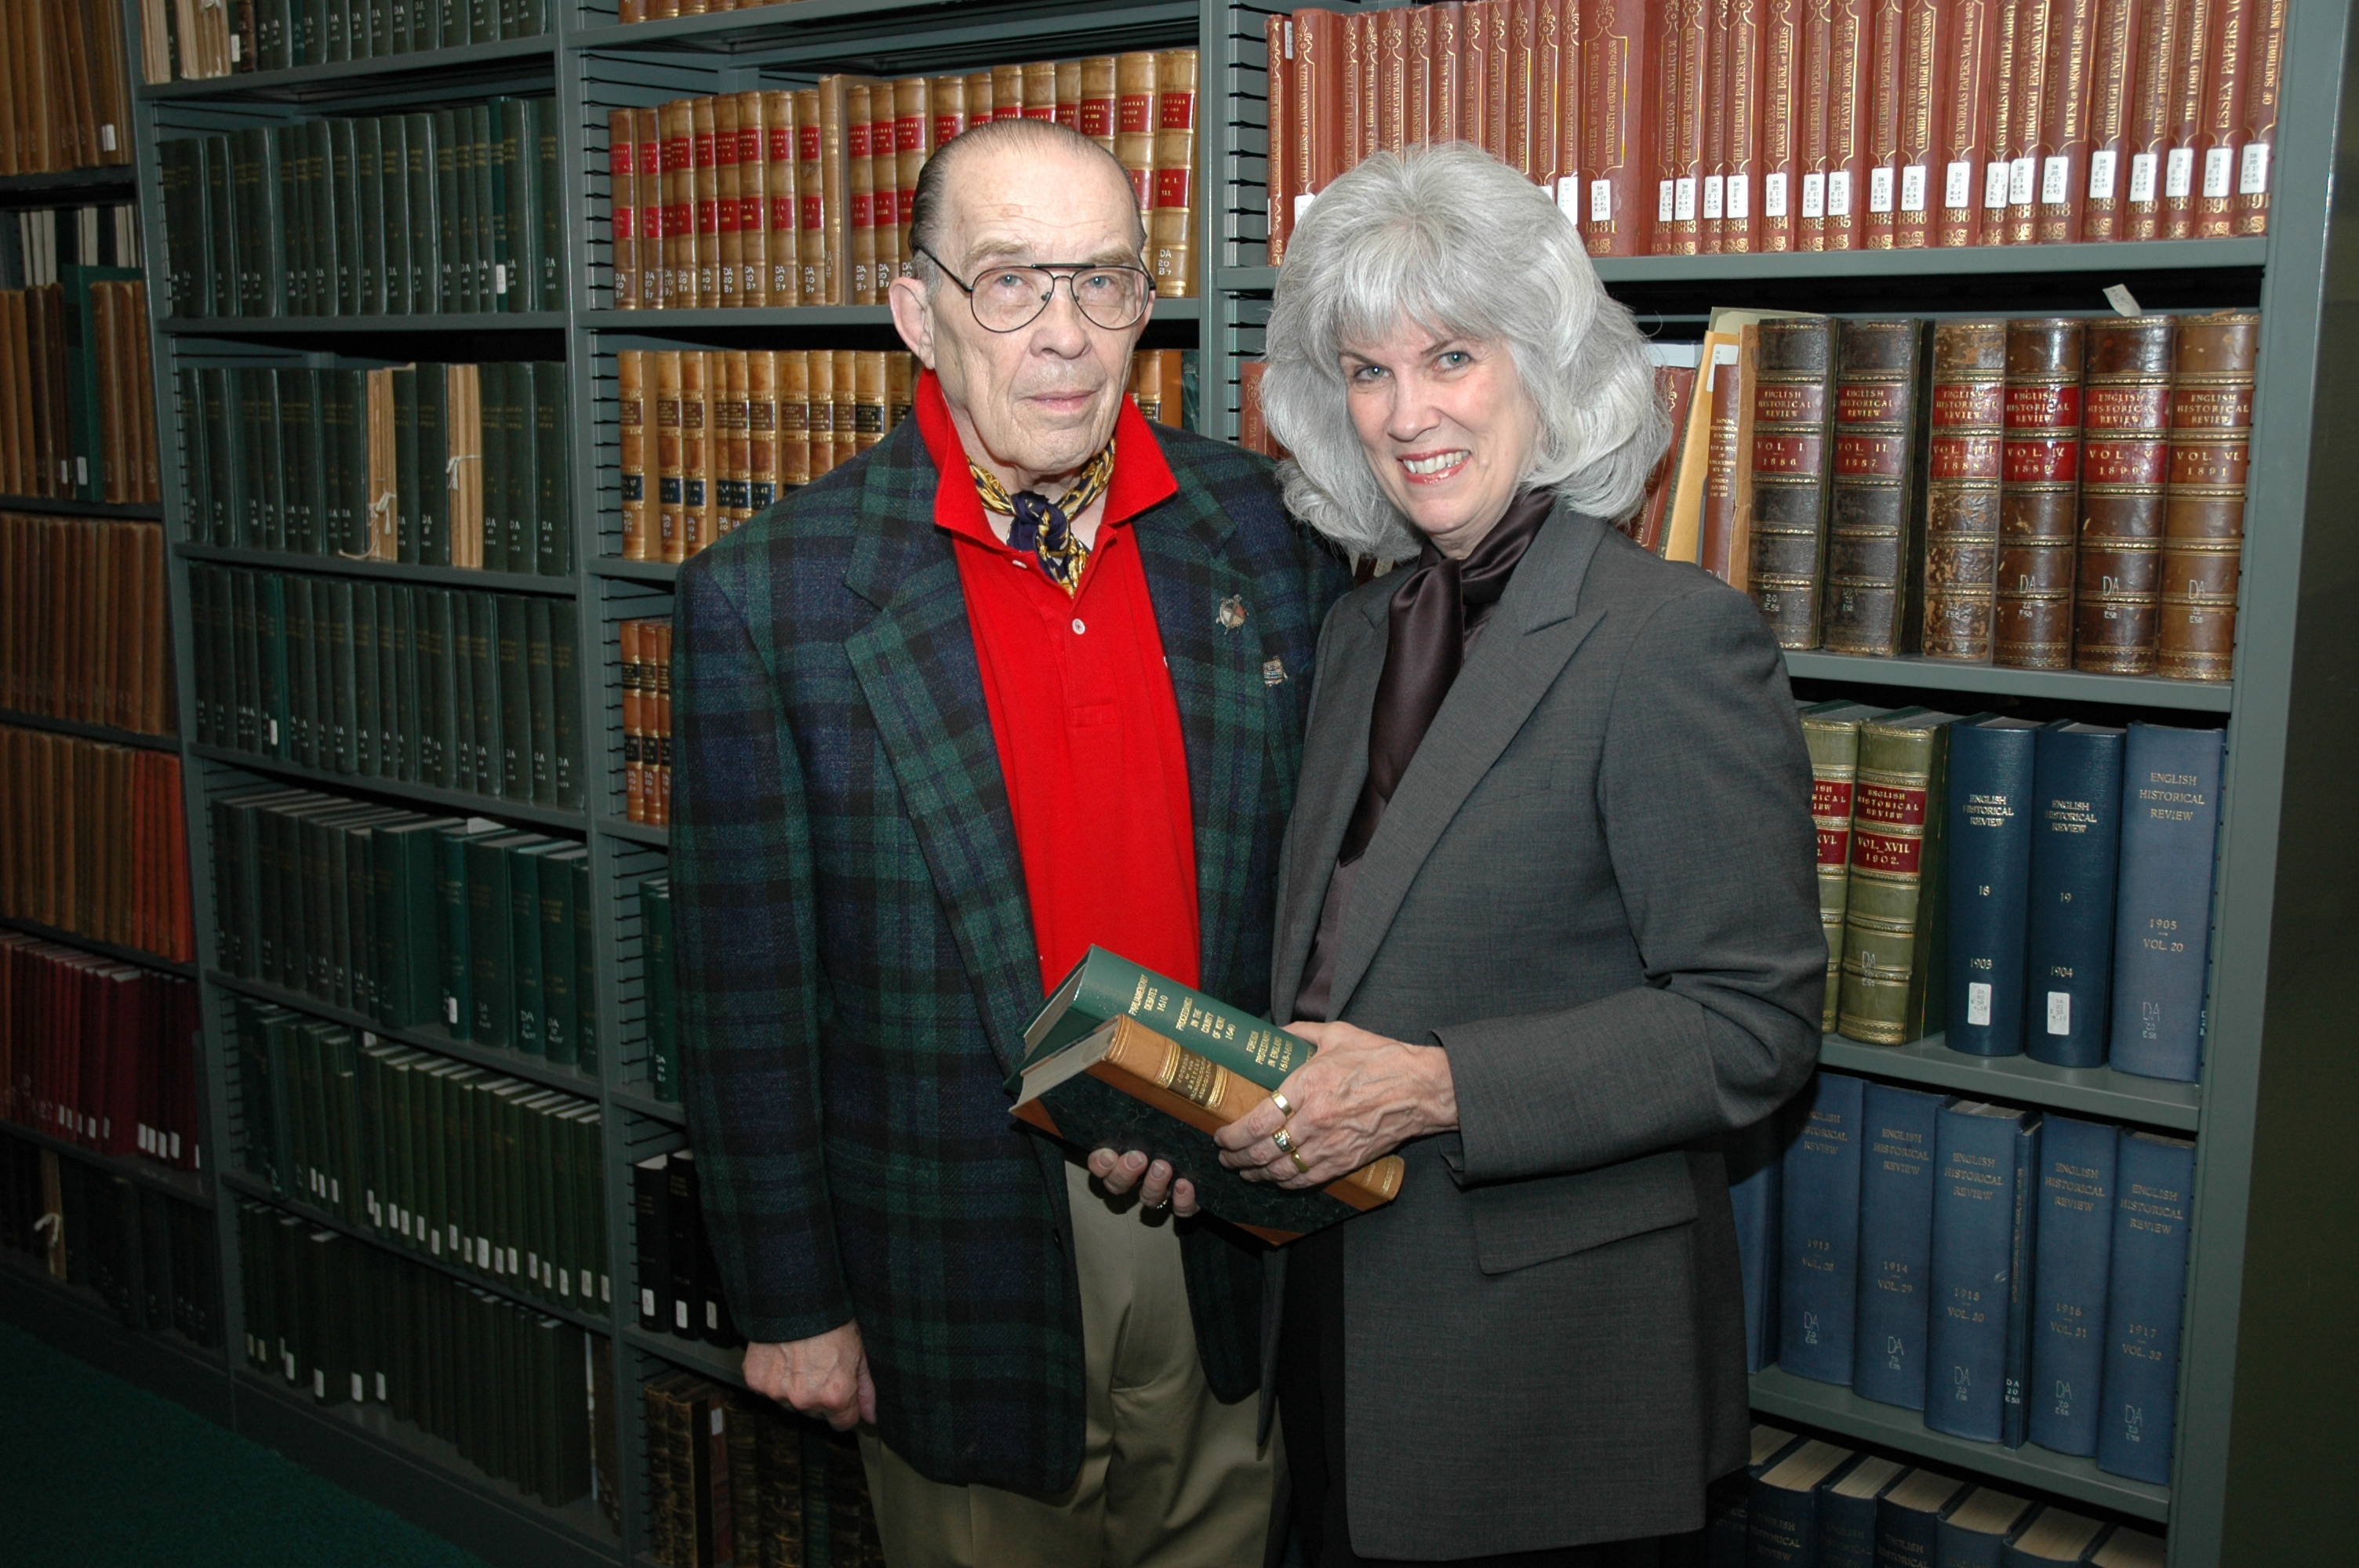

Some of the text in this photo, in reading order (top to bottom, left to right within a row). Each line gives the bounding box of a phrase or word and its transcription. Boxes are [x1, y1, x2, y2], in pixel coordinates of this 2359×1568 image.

[1910, 13, 1920, 35] STAR
[1779, 27, 1789, 53] LEEDS
[1910, 38, 1918, 47] OF
[2021, 11, 2031, 60] TRAVELS
[1844, 48, 1852, 57] OF
[1999, 40, 2012, 78] BATTLE
[1590, 55, 1599, 95] VISITORS
[1842, 61, 1852, 87] BOOK
[1908, 53, 1917, 85] COURTS
[2045, 14, 2062, 127] VISITATION OF THE
[2215, 16, 2238, 129] ESSEX PAPERS.
[2262, 32, 2279, 105] OF SOUTHWELL
[1778, 65, 1787, 89] DUKE
[1916, 11, 1932, 148] CHAMBER AND HIGH COMMISSION
[2249, 37, 2264, 118] VISITATIONS AND
[1831, 25, 1843, 151] TROUBLES CONNECTED WITH
[1998, 80, 2008, 93] OF
[2185, 65, 2200, 122] THE LORD
[1666, 40, 1677, 162] CATHOLICON ANGLICUM
[1907, 87, 1916, 104] THE
[1777, 95, 1787, 118] FIFTH
[1841, 92, 1851, 129] PRAYER
[1907, 107, 1914, 115] IN
[2105, 84, 2118, 135] THROUGH
[1588, 127, 1598, 166] REGISTER
[1776, 123, 1786, 157] FRANCIS
[1840, 135, 1849, 154] THE
[2199, 197, 2234, 214] 1890
[1826, 215, 1851, 227] 1885
[1898, 211, 1928, 224] 1886
[1586, 220, 1616, 234] 1881
[1159, 249, 1172, 259] DA
[723, 267, 732, 276] DA
[775, 265, 785, 274] DA
[1765, 390, 1801, 399] ENGLISH
[1943, 390, 1984, 400] ENGLISH
[2014, 392, 2058, 401] ENGLISH
[2099, 394, 2144, 402] ENGLISH
[2191, 394, 2236, 403] ENGLISH
[1758, 400, 1812, 408] HISTORICAL
[1840, 399, 1893, 408] HISTORICAL
[1936, 400, 1998, 408] HISTORICAL
[2007, 403, 2070, 412] HISTORICAL
[2177, 405, 2250, 413] HISTORICAL
[2016, 415, 2054, 423] REVIEW
[2100, 416, 2141, 424] REVIEW
[485, 517, 496, 527] DA
[510, 520, 521, 530] DA
[542, 521, 552, 532] DA
[2020, 575, 2037, 593] DA
[2102, 575, 2119, 596] DA
[2188, 580, 2205, 600] DA
[558, 757, 569, 767] DA
[2150, 771, 2197, 786] ENGLISH
[1866, 789, 1906, 800] ENGLISH
[1968, 793, 2008, 805] ENGLISH
[2139, 789, 2205, 805] HISTORICAL
[1857, 795, 1919, 811] HISTORICAL
[1962, 804, 2014, 816] HISTORICAL
[2052, 800, 2090, 811] ENGLISH
[1866, 808, 1903, 819] REVIEW
[1970, 815, 2005, 827] REVIEW
[2045, 809, 2098, 823] HISTORICAL
[2150, 808, 2194, 822] REVIEW
[2052, 822, 2086, 833] REVIEW
[1979, 884, 1990, 895] 18
[2059, 892, 2072, 903] 19
[2149, 918, 2177, 931] 1905
[2143, 938, 2184, 953] VOL. 20
[1862, 950, 1876, 969] DA
[1970, 958, 1993, 970] 1903
[2050, 966, 2074, 978] 1904
[1129, 974, 1149, 1016] PARLIAMENTARY
[1143, 986, 1158, 1011] DEBATES
[1157, 994, 1169, 1011] 1610
[521, 1010, 535, 1023] DA
[1176, 996, 1194, 1032] PROCEEDINGS
[2143, 1001, 2161, 1022] DA
[1201, 1011, 1215, 1034] COUNTY
[1212, 1014, 1226, 1040] OF KENT
[1225, 1023, 1237, 1040] 1640
[1245, 1030, 1259, 1054] FOREIGN
[1255, 1029, 1271, 1065] PROTESTANTS
[1267, 1036, 1283, 1068] IN ENGLAND
[1178, 1054, 1190, 1083] JOURNAL
[1882, 1128, 1921, 1143] ENGLISH
[1804, 1140, 1839, 1154] REVIEW
[1874, 1142, 1929, 1160] HISTORICAL
[1884, 1160, 1920, 1174] REVIEW
[1953, 1152, 1996, 1168] ENGLISH
[1945, 1167, 2004, 1185] HISTORICAL
[2055, 1162, 2099, 1179] ENGLISH
[1953, 1185, 1993, 1200] REVIEW
[2045, 1176, 2106, 1196] HISTORICAL
[2132, 1184, 2179, 1201] ENGLISH
[2055, 1196, 2094, 1212] REVIEW
[2121, 1198, 2183, 1221] HISTORICAL
[2130, 1217, 2172, 1235] REVIEW
[1808, 1239, 1830, 1251] 1913
[1884, 1261, 1908, 1273] 1914
[1954, 1287, 1981, 1301] 1915
[2056, 1303, 2083, 1317] 1916
[1804, 1311, 1819, 1331] DA
[2128, 1323, 2157, 1338] 1917
[1887, 1336, 1904, 1356] DA
[1954, 1366, 1971, 1386] DA
[2006, 1378, 2020, 1388] DA
[2055, 1380, 2072, 1400] DA
[2125, 1403, 2143, 1427] DA
[1757, 1512, 1794, 1532] ENGLISH
[1750, 1524, 1801, 1548] HISTORICAL
[1885, 1534, 1924, 1554] ENGLISH
